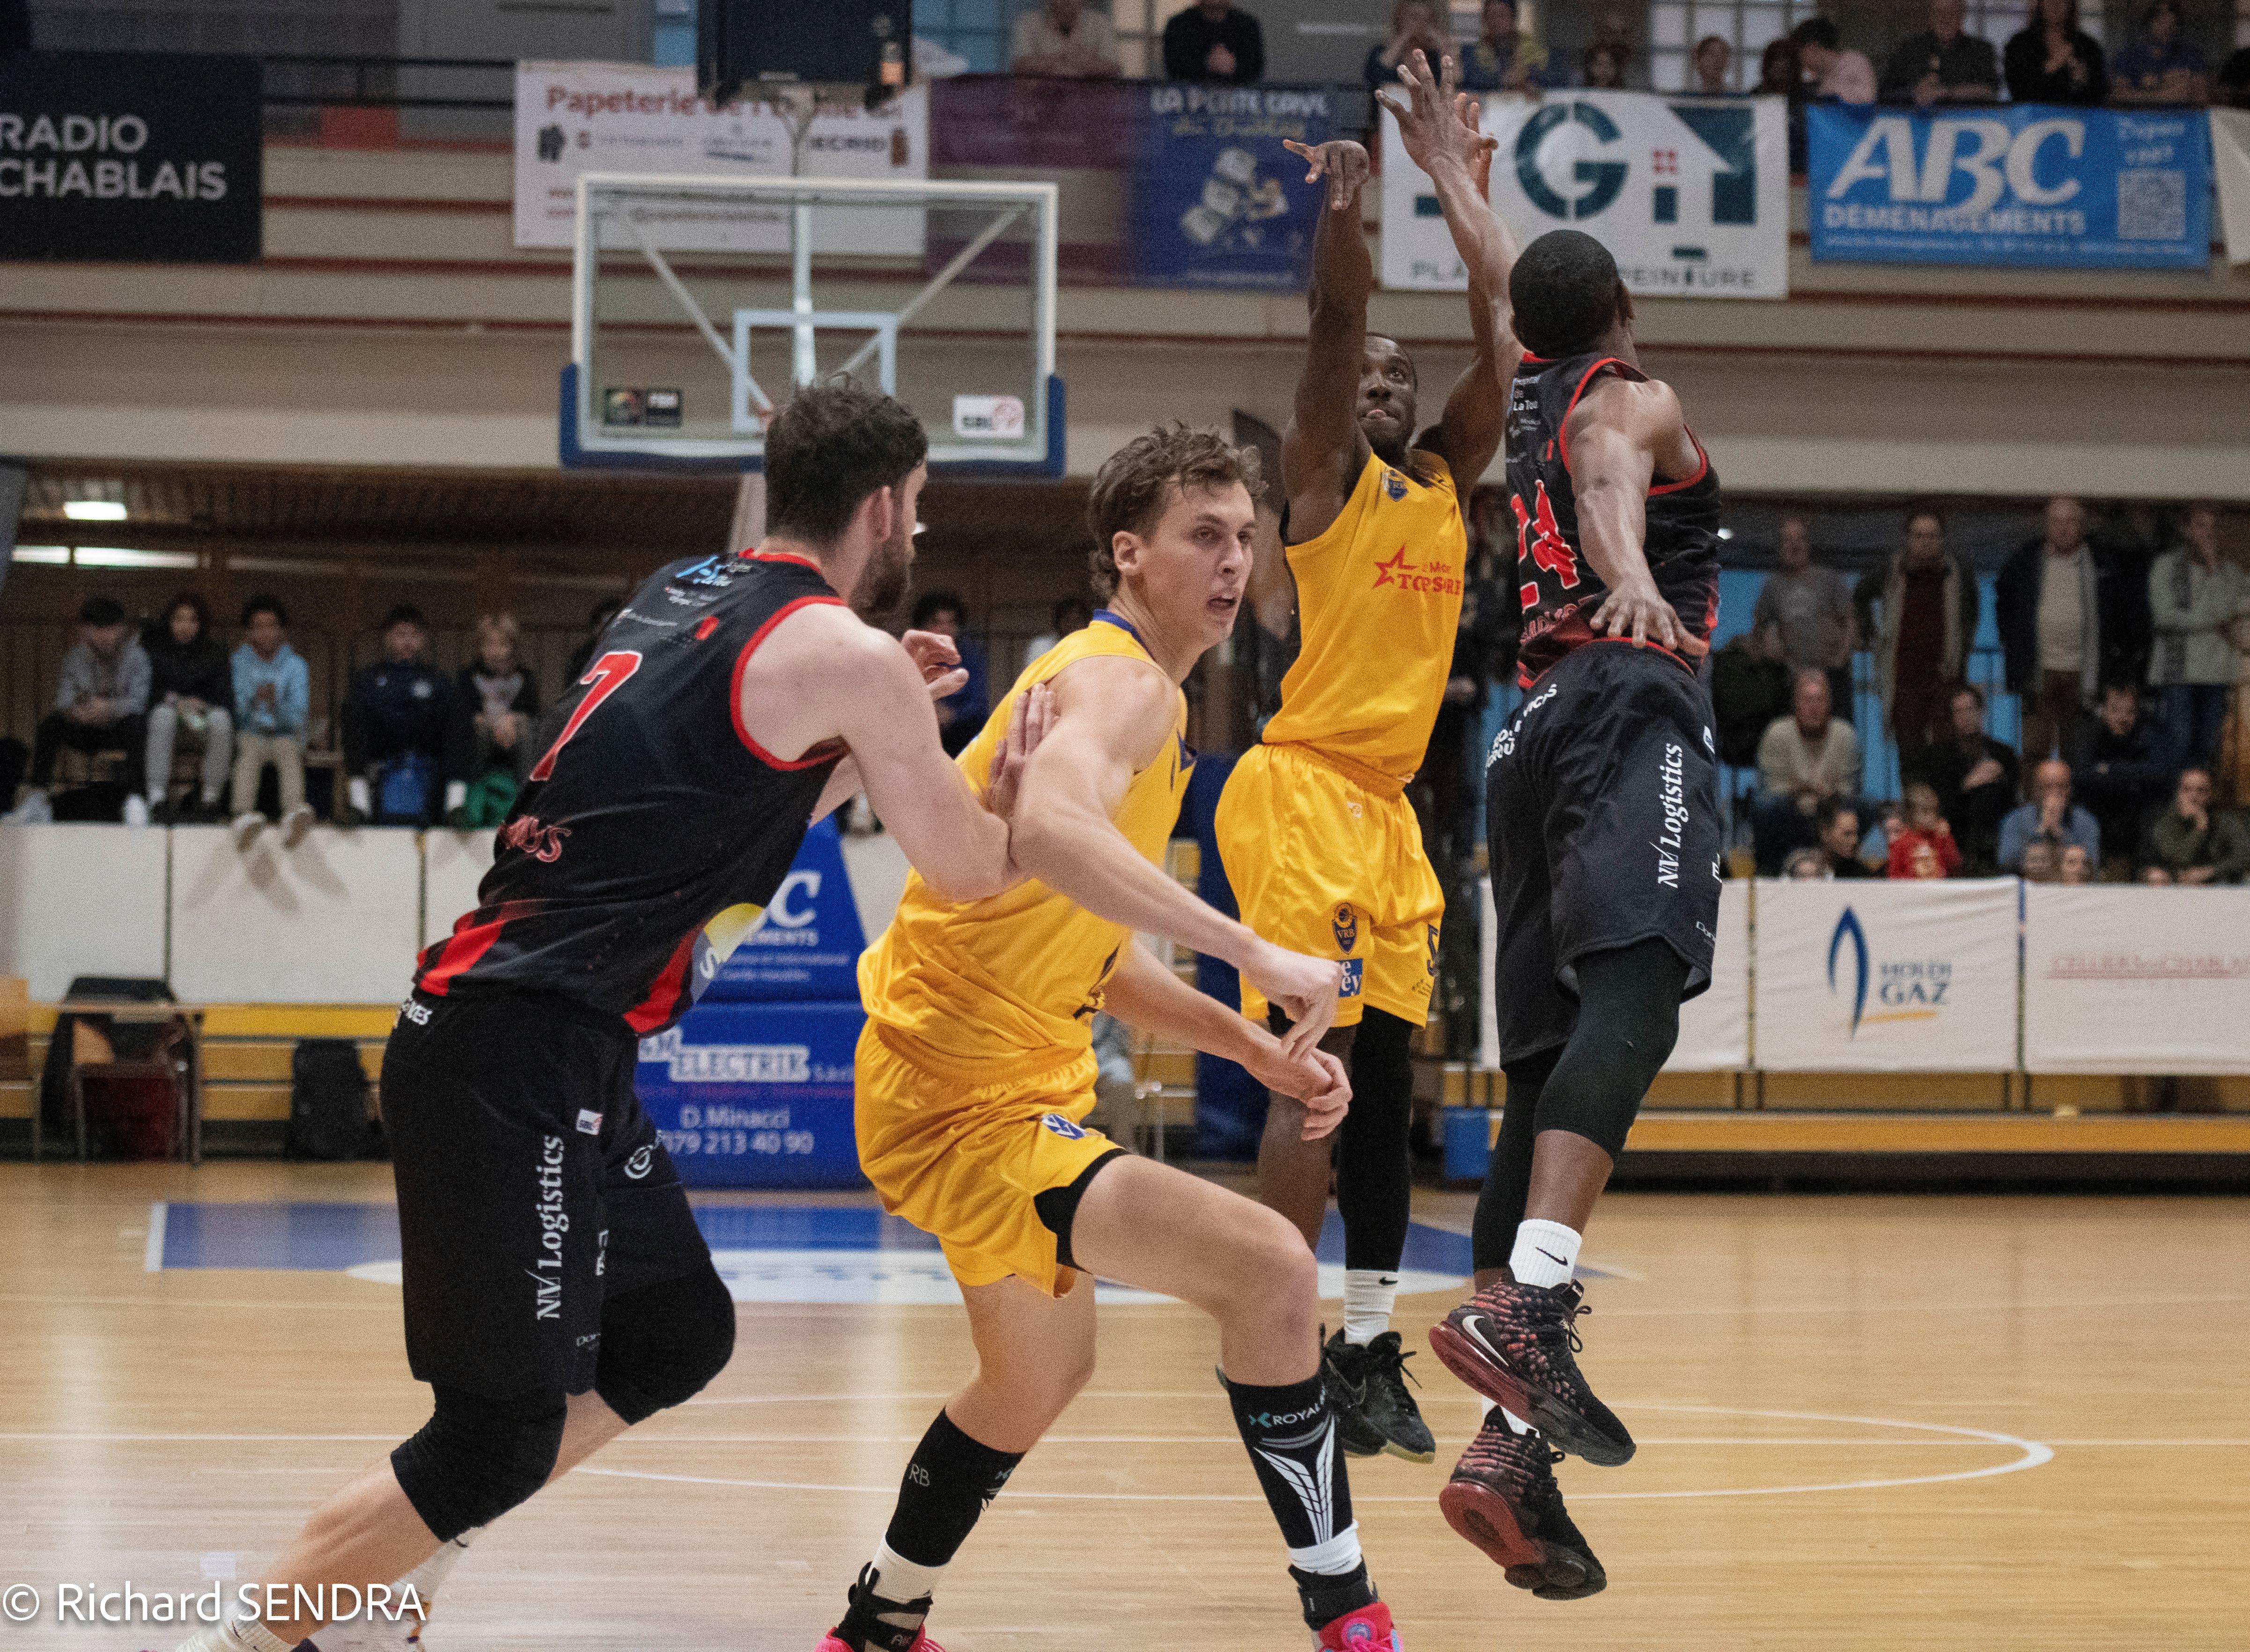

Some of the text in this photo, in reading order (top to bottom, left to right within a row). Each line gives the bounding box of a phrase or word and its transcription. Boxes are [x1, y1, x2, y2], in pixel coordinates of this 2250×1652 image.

[546, 85, 698, 119] Papeterie
[0, 113, 149, 153] RADIO
[0, 157, 229, 201] CHABLAIS
[1826, 115, 2086, 216] ABC
[529, 650, 643, 781] 7
[1659, 743, 1689, 848] Logistics
[1880, 981, 1949, 1006] GAZ
[704, 1130, 747, 1154] 213
[751, 1130, 781, 1154] 40
[784, 1130, 815, 1154] 90
[536, 1134, 569, 1270] Logistics
